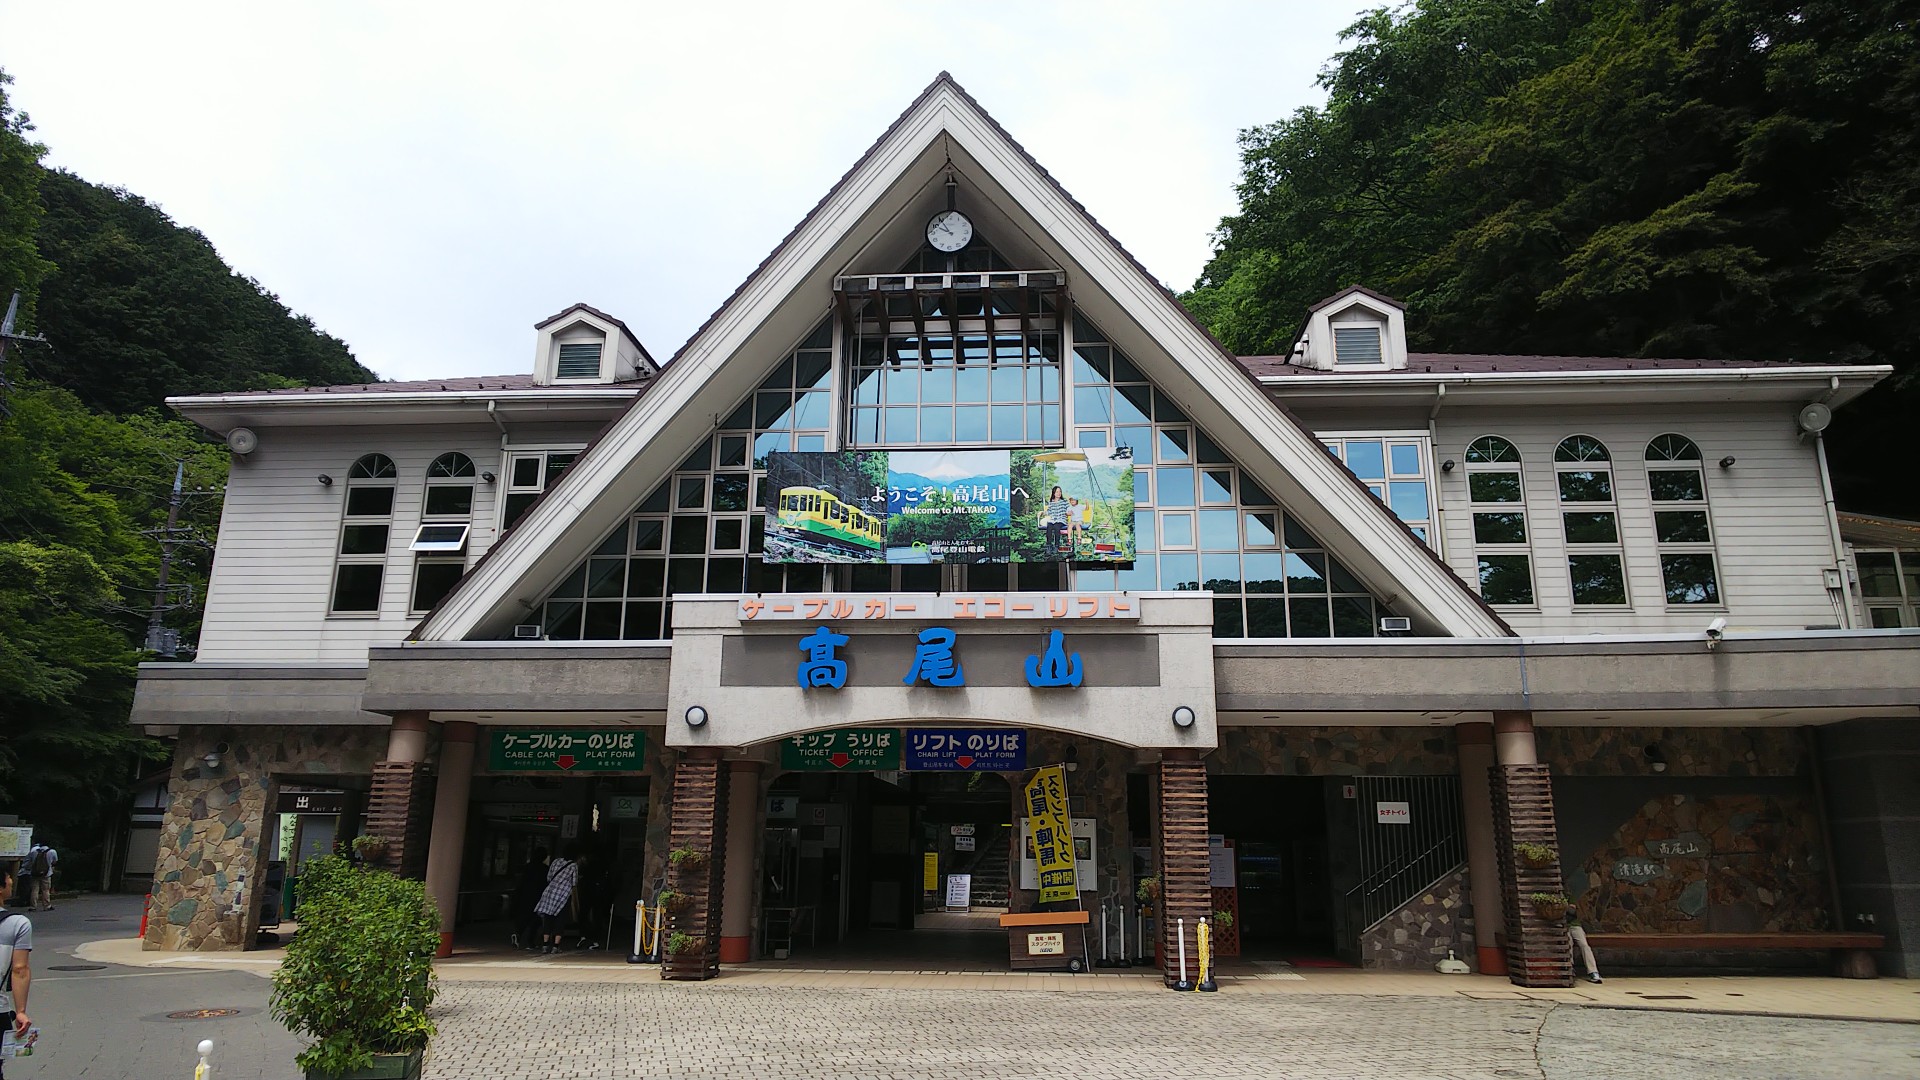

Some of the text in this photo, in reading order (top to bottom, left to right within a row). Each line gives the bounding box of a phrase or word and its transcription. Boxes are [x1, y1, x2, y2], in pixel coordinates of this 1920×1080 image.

[902, 506, 996, 514] Welcome to Mt.TAKAO
[742, 598, 1130, 619] ケーブルカー エコーリフト
[502, 733, 634, 749] ケーブルカーのりば
[792, 732, 891, 747] キップ うりば
[914, 734, 1020, 750] リフト のりば
[1660, 842, 1698, 854] 高尾山
